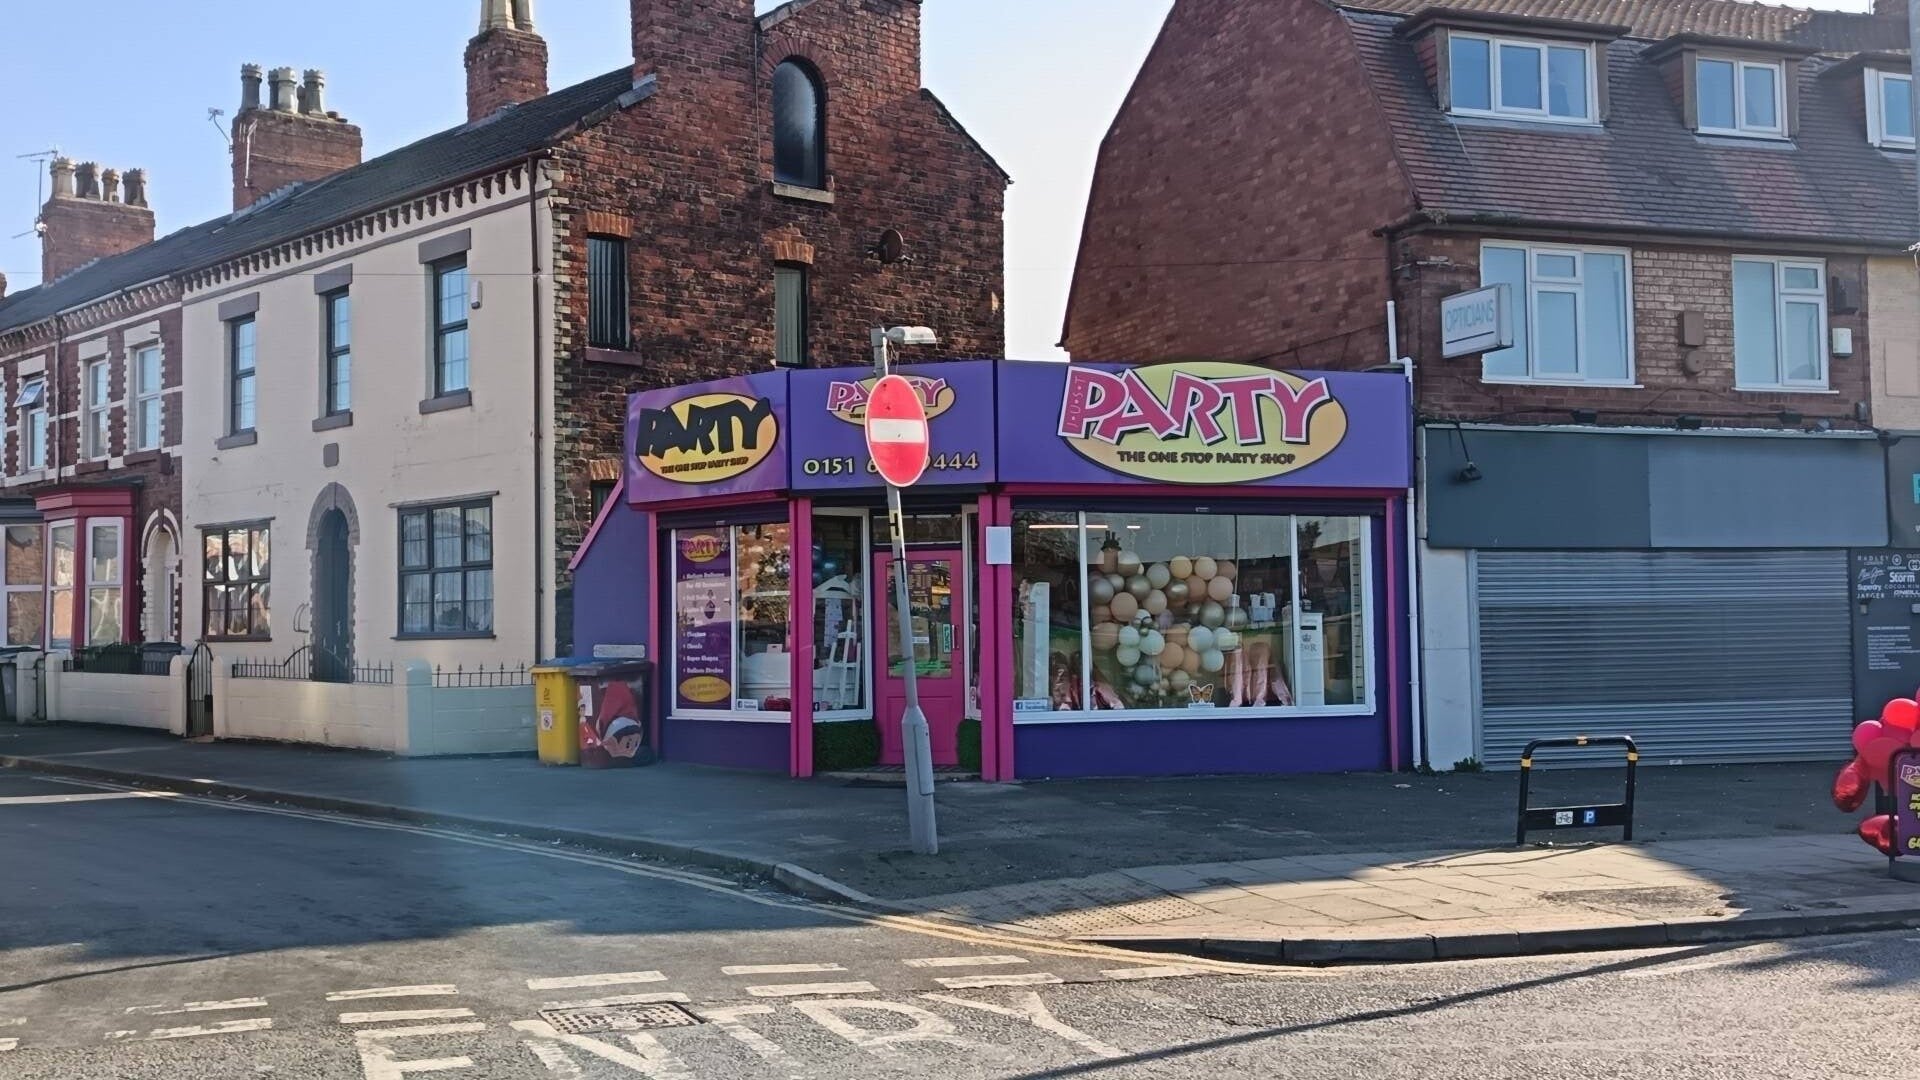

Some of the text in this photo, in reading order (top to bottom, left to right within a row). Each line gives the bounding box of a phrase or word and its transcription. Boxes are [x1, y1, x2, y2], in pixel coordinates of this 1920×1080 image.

[1446, 299, 1494, 332] OPTICIANS
[827, 378, 947, 413] PAY
[1058, 365, 1331, 446] PARTY
[635, 397, 770, 459] PARTY
[660, 456, 749, 474] THE ONE STOP PARTY SHOP
[804, 457, 853, 474] 0151
[1117, 450, 1296, 465] THE ONE STOP PARTY SHOP
[1889, 571, 1916, 583] Storm
